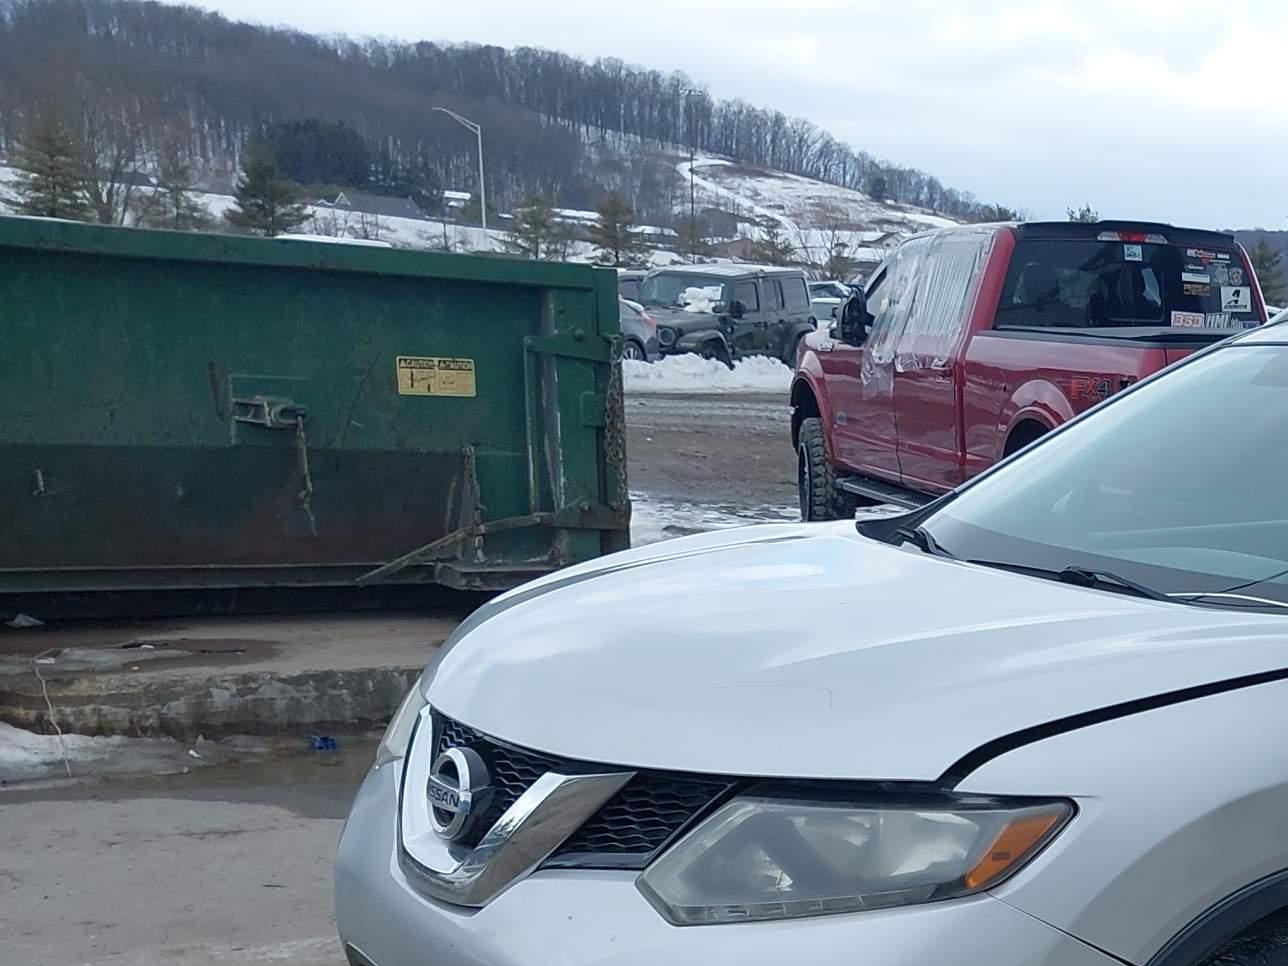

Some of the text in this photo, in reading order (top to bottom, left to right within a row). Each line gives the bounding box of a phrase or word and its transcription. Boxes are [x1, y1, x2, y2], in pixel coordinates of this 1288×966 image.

[406, 359, 434, 369] CAUTION
[1071, 375, 1112, 399] FX4
[429, 784, 459, 807] SSAN
